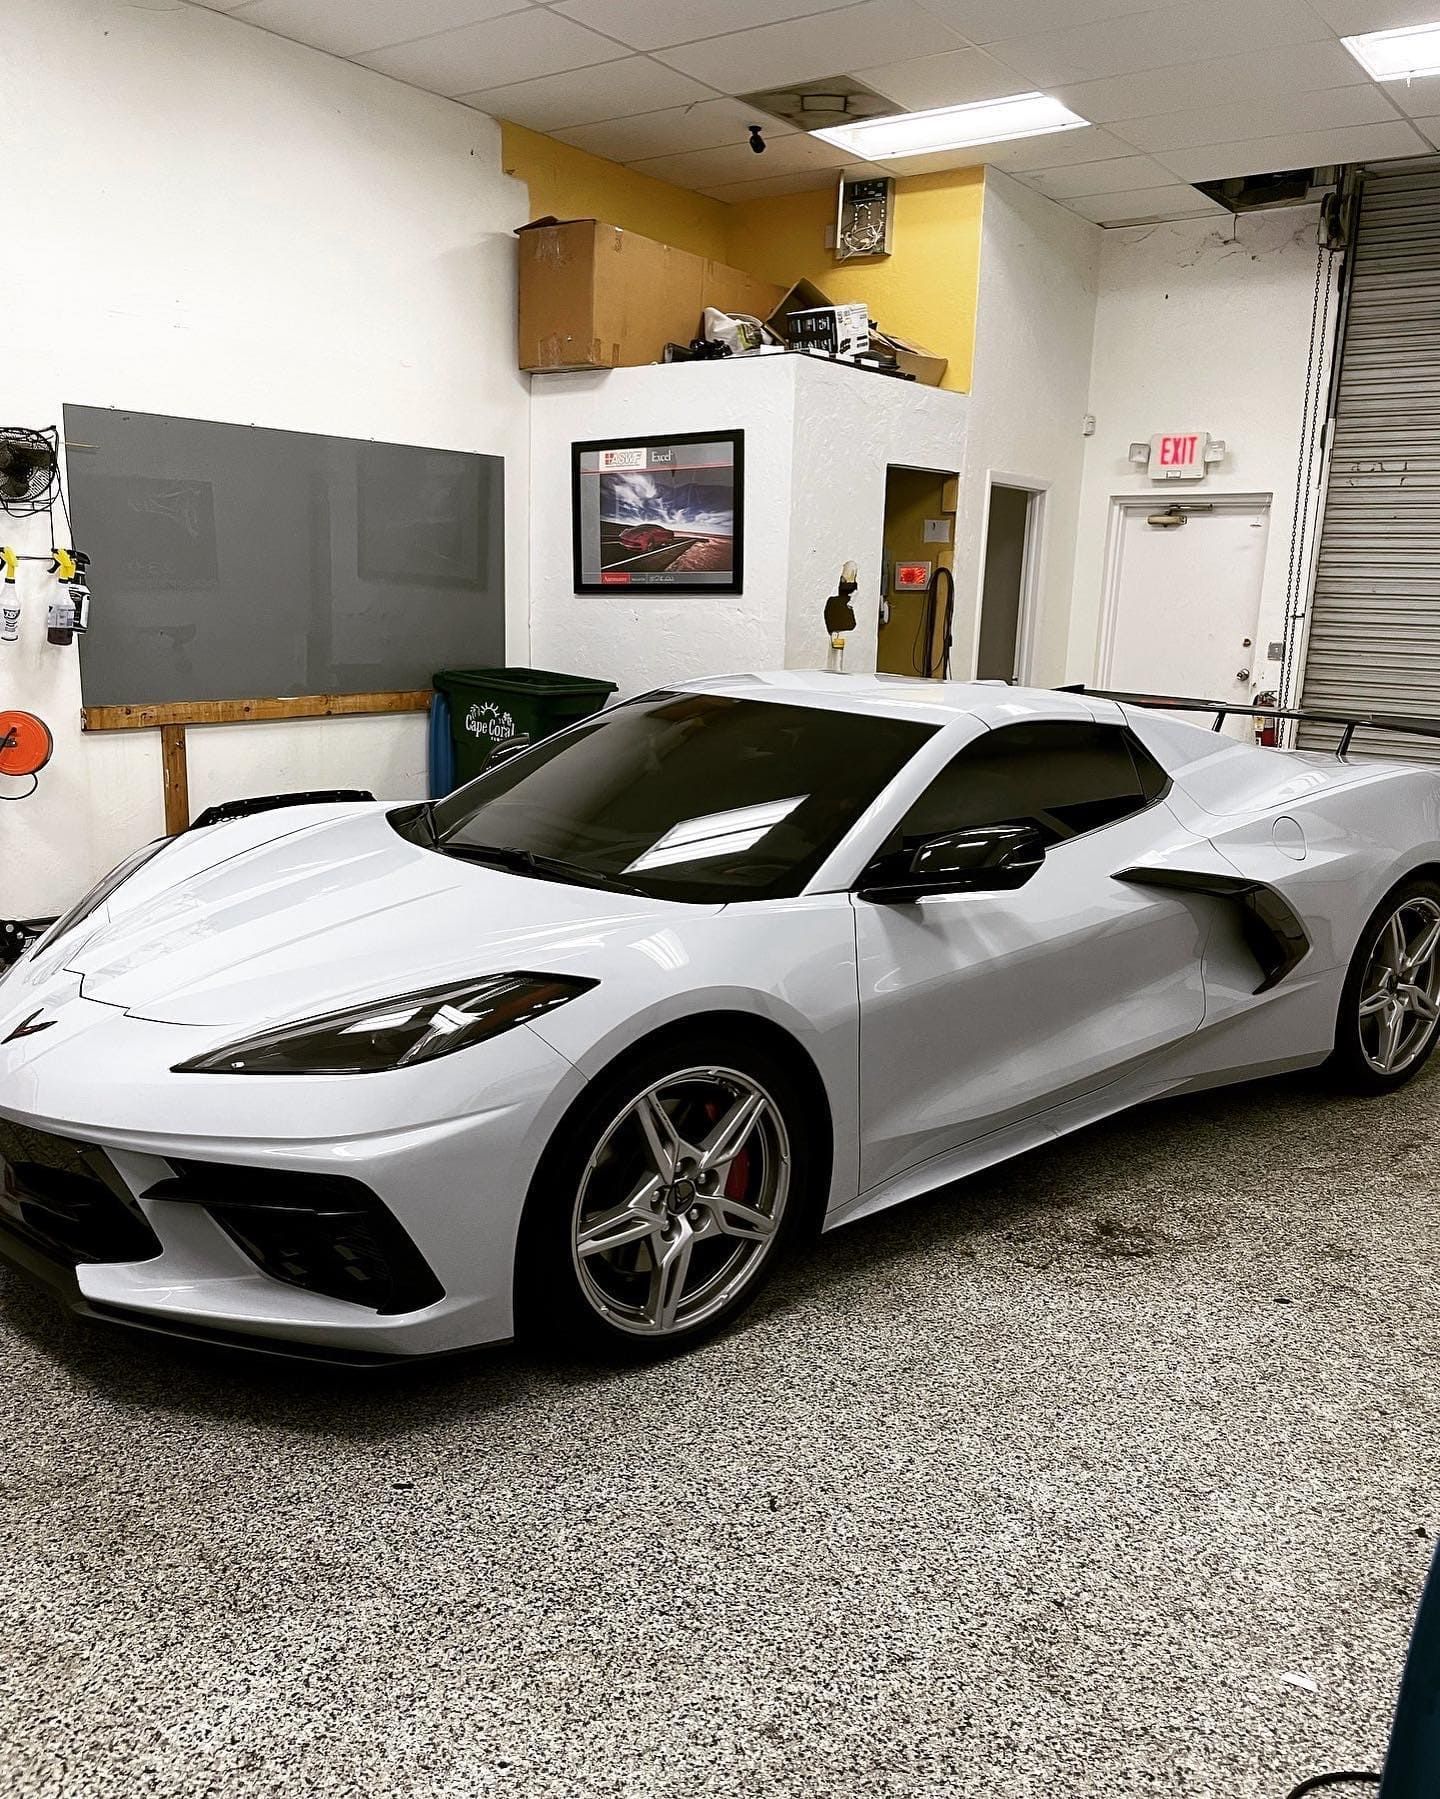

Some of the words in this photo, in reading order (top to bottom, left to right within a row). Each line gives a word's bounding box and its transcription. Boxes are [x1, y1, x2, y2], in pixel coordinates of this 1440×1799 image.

[1160, 436, 1198, 465] EXIT
[465, 714, 488, 738] Cape
[488, 718, 515, 739] Coral
